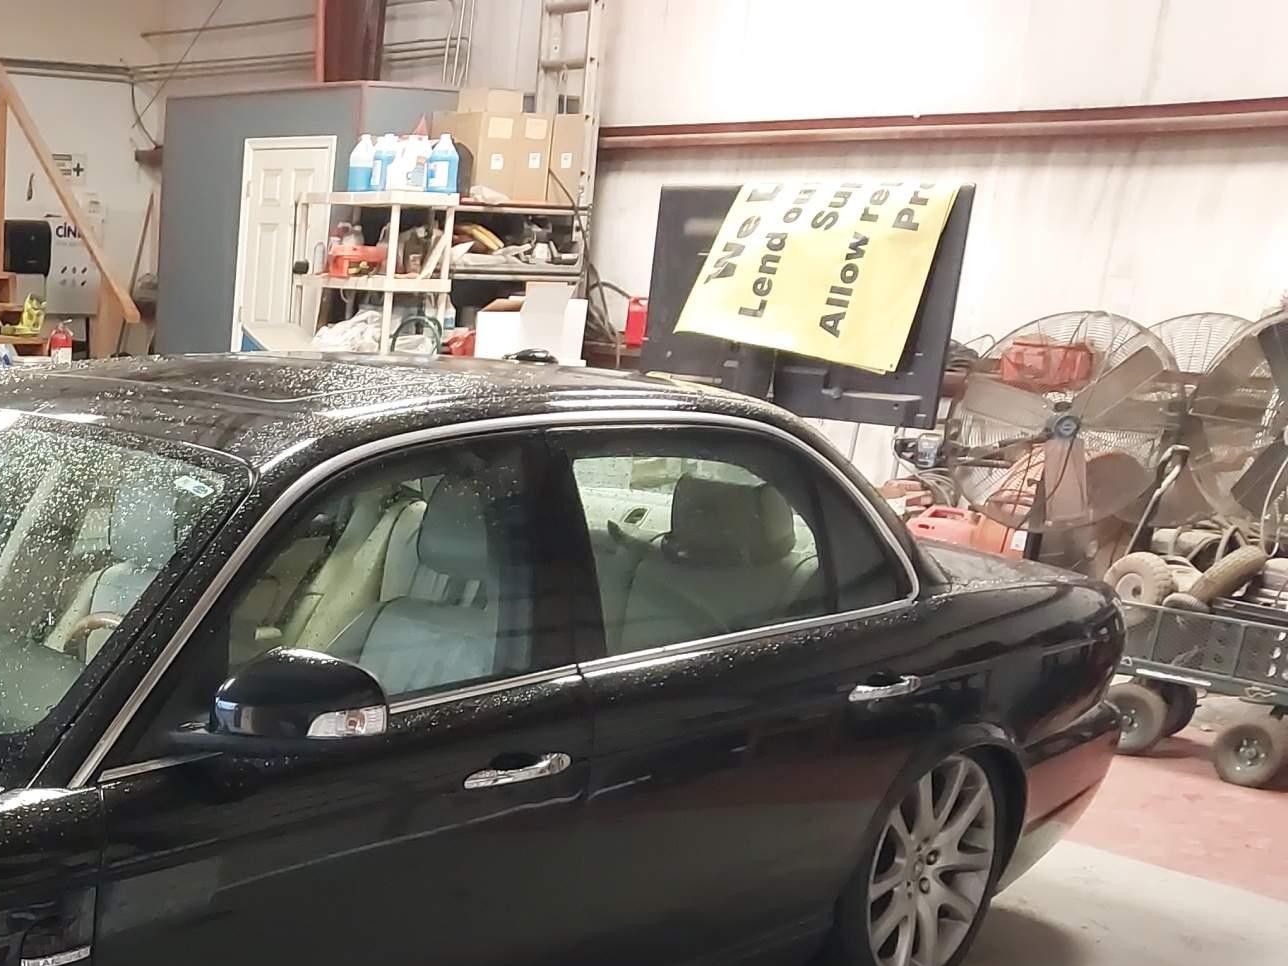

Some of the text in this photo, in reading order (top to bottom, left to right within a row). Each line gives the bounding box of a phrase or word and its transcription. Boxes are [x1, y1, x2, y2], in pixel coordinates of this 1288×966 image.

[55, 222, 81, 239] CIN
[810, 183, 863, 231] Su
[892, 184, 935, 231] Pr
[704, 215, 761, 284] We
[738, 183, 818, 318] Lend ou
[819, 183, 903, 338] Allow re
